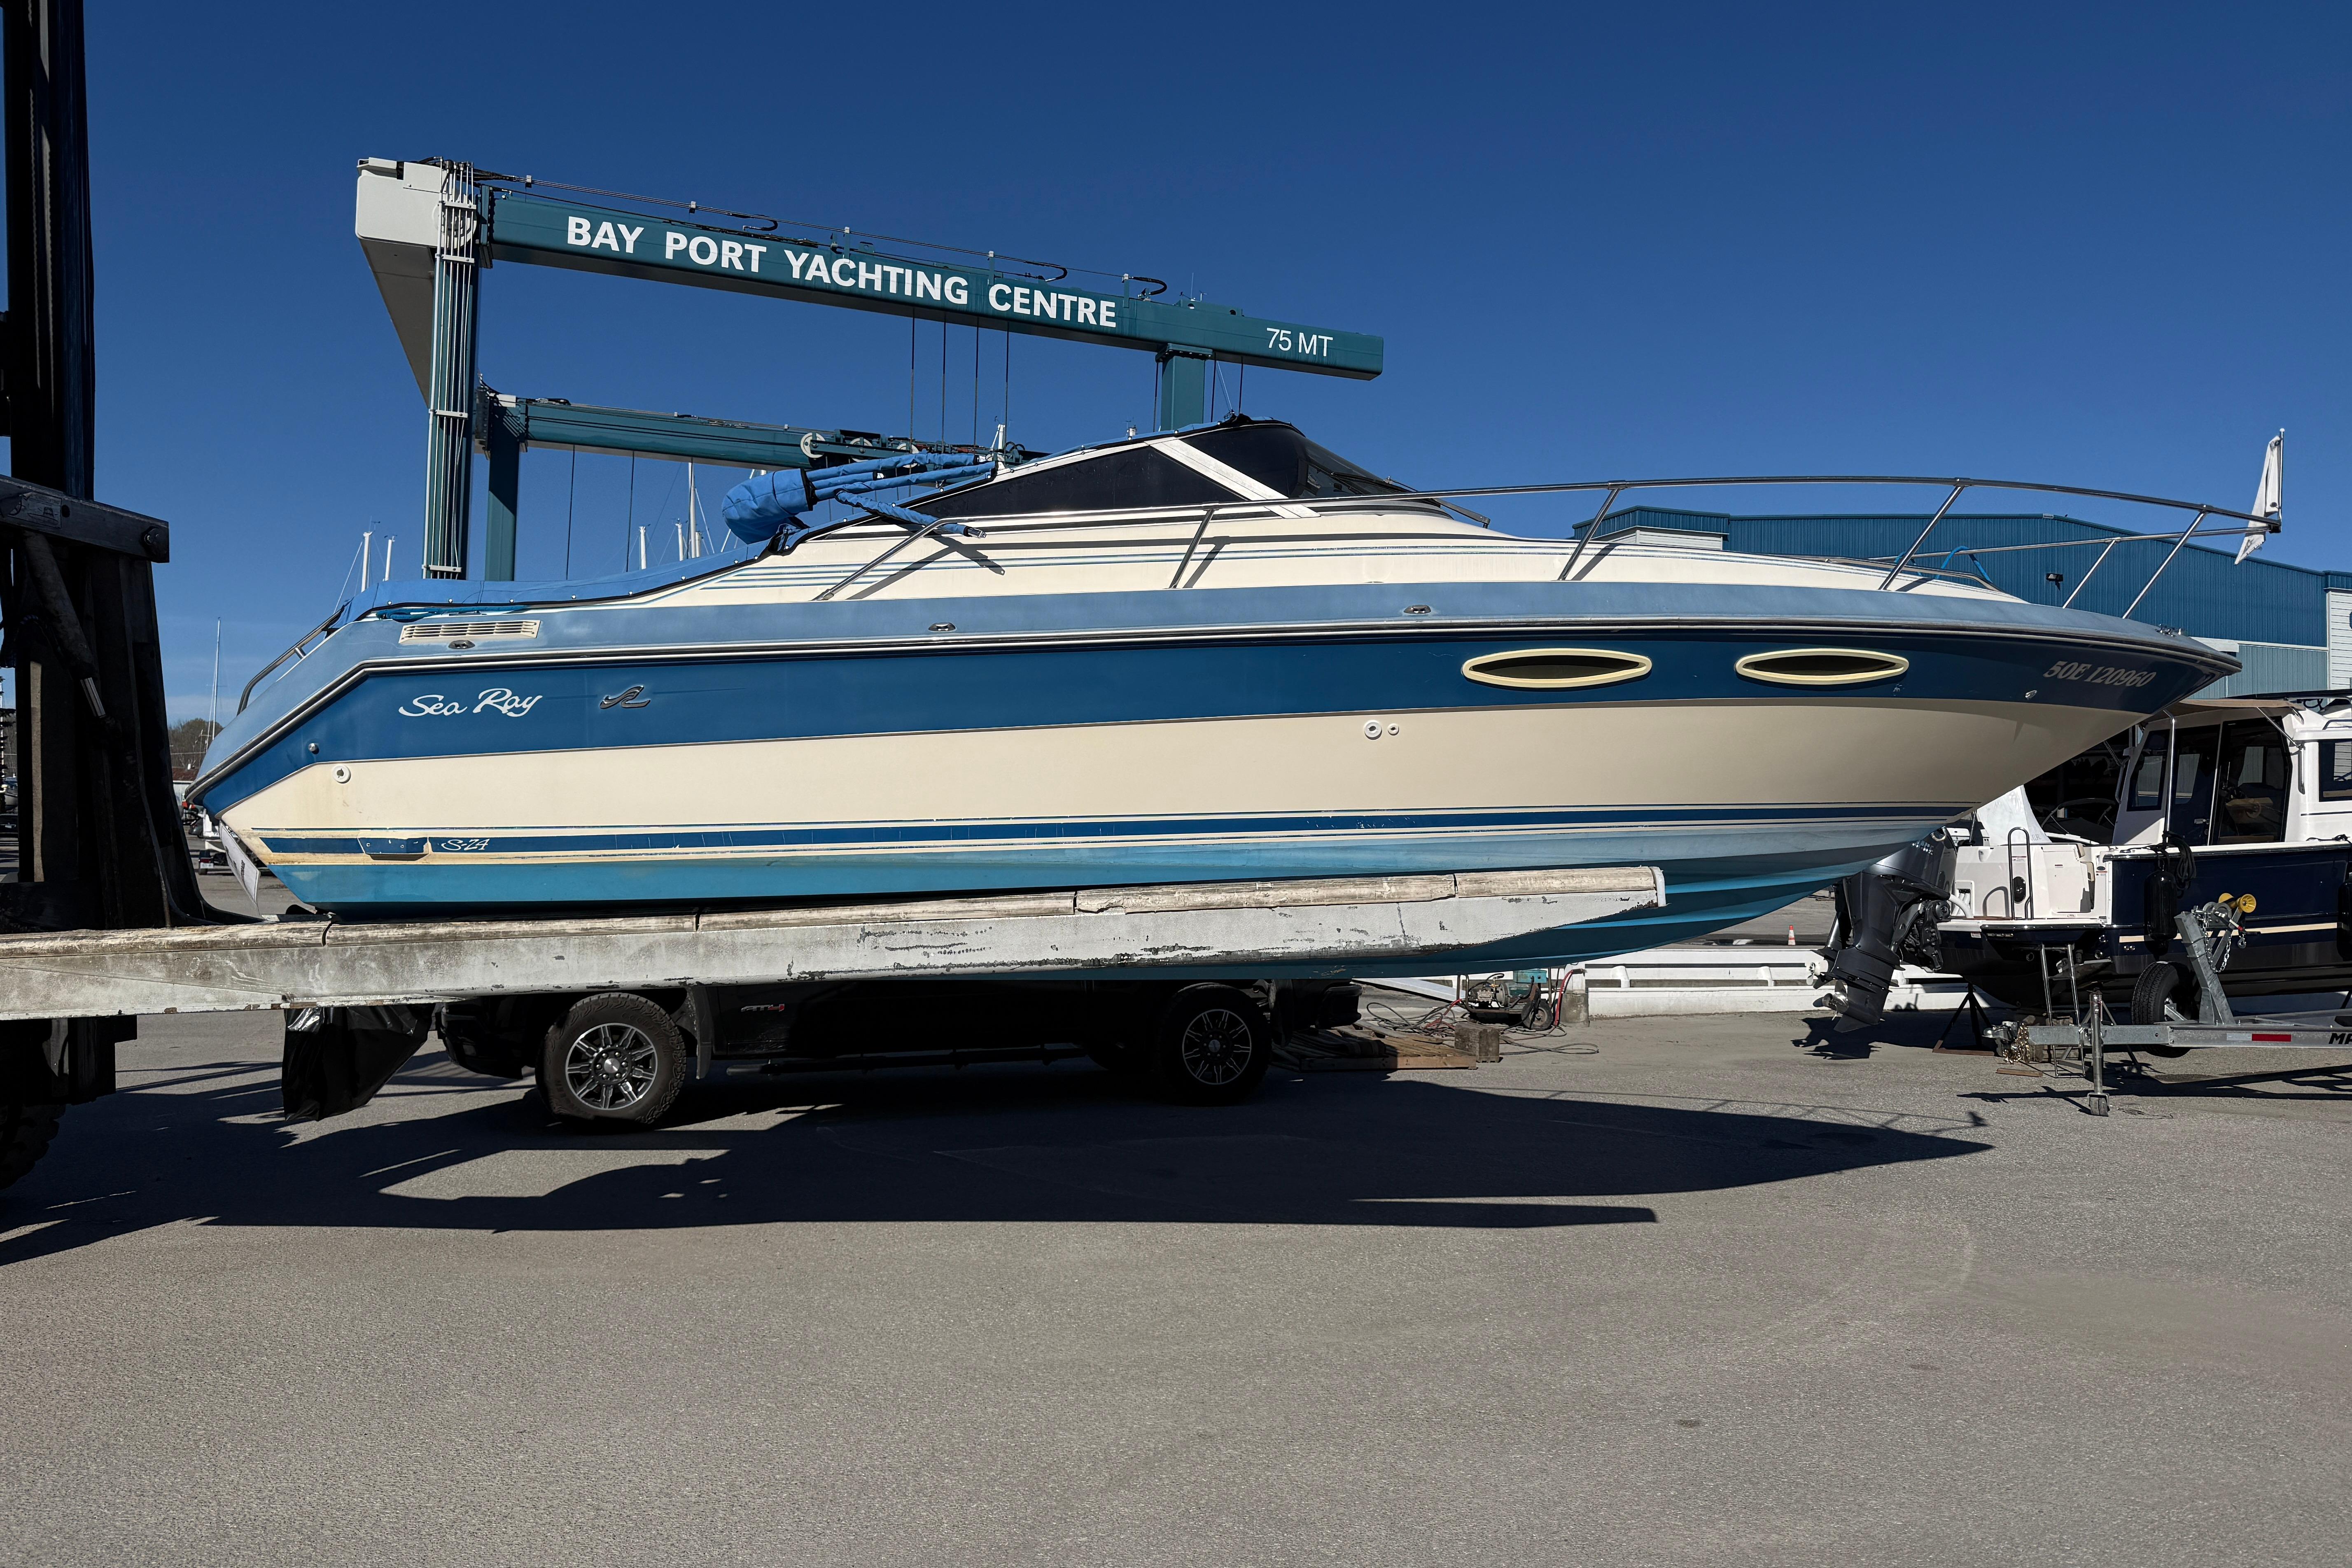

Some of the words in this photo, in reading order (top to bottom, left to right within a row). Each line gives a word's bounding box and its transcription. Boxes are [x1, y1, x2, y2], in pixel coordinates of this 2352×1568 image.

[567, 216, 644, 254] BAY
[665, 231, 767, 273] PORT
[784, 249, 968, 304] YACHTING
[988, 284, 1117, 327] CENTRE
[1266, 327, 1292, 351] 75
[1297, 332, 1333, 357] MT
[2043, 661, 2092, 680] 50E
[2084, 666, 2157, 687] 120960
[398, 695, 468, 717] Sea
[472, 688, 543, 717] Ray
[441, 838, 490, 851] S-24
